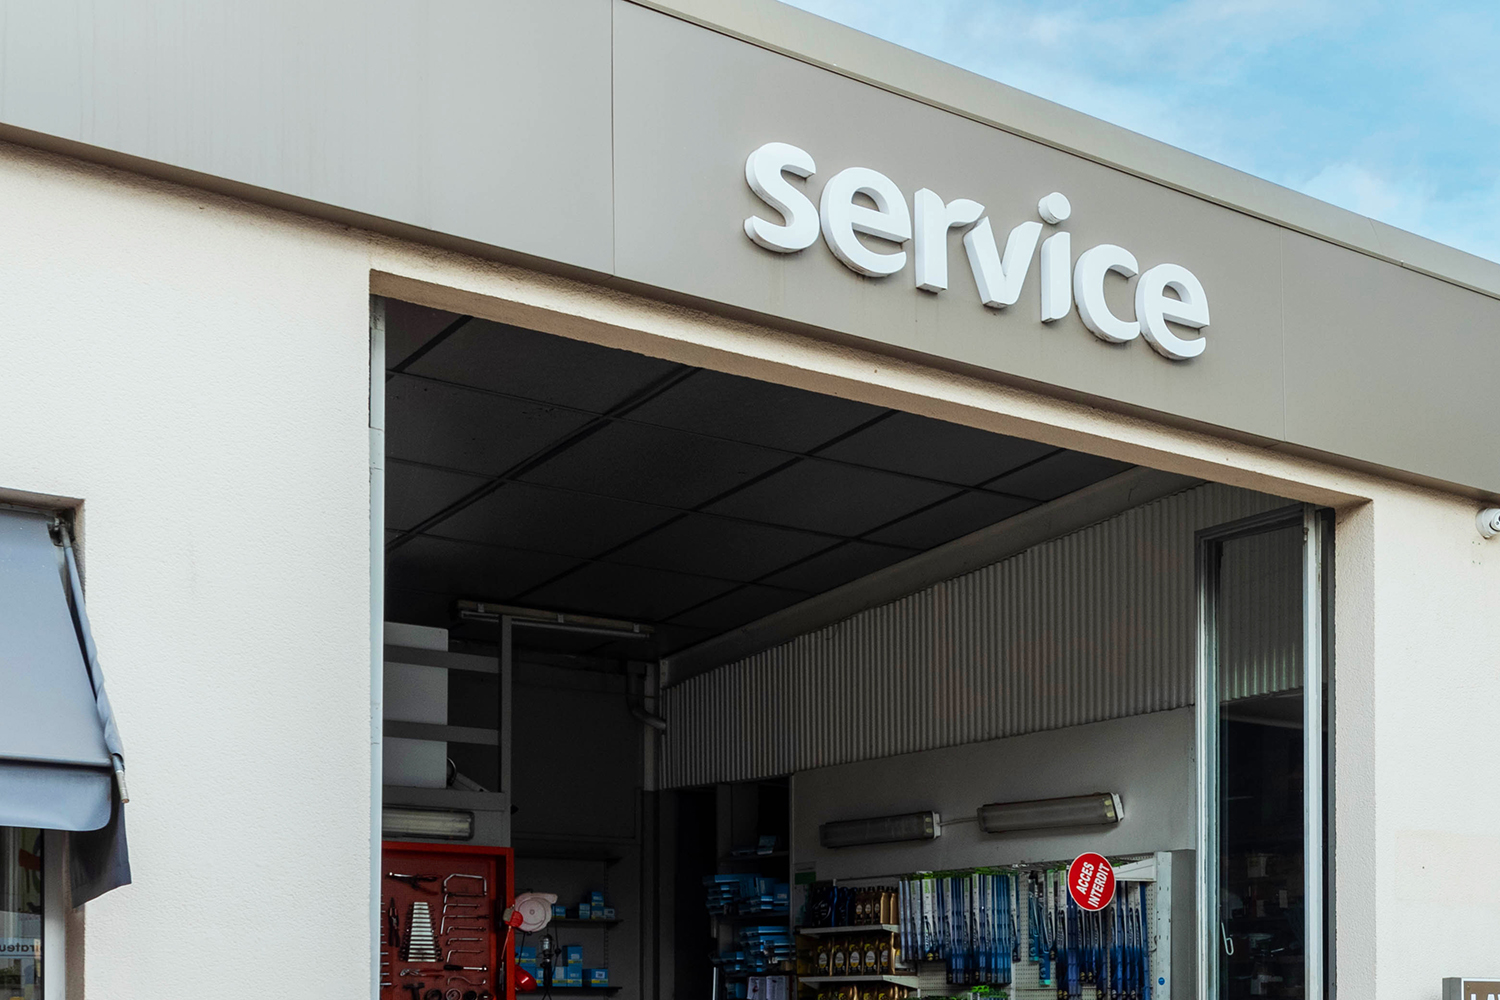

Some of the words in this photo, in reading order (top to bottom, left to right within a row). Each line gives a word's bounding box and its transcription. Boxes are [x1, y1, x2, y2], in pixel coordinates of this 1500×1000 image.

[743, 142, 1210, 360] service
[1076, 861, 1095, 895] ACCES
[1087, 862, 1110, 908] INTERDIT
